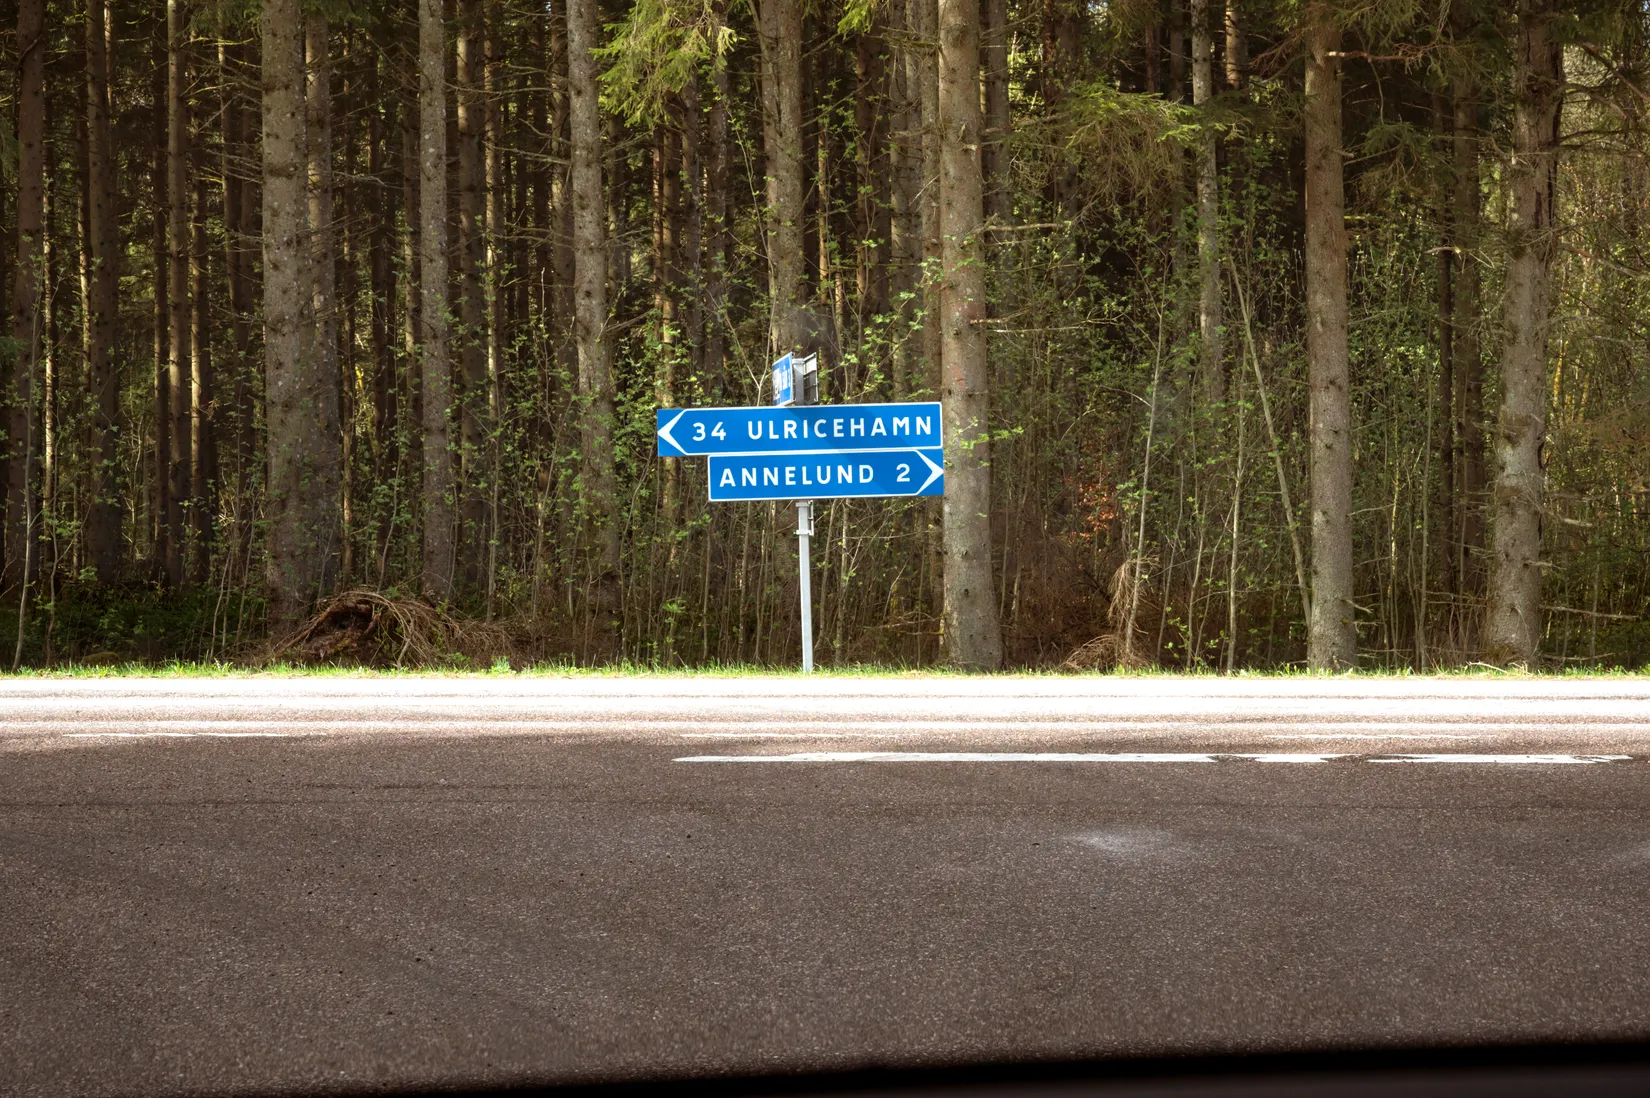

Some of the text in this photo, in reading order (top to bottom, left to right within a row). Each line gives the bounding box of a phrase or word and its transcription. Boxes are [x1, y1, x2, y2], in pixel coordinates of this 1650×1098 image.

[692, 416, 931, 441] 34 ULRICEHAMN
[719, 463, 911, 487] ANNELUND 2
